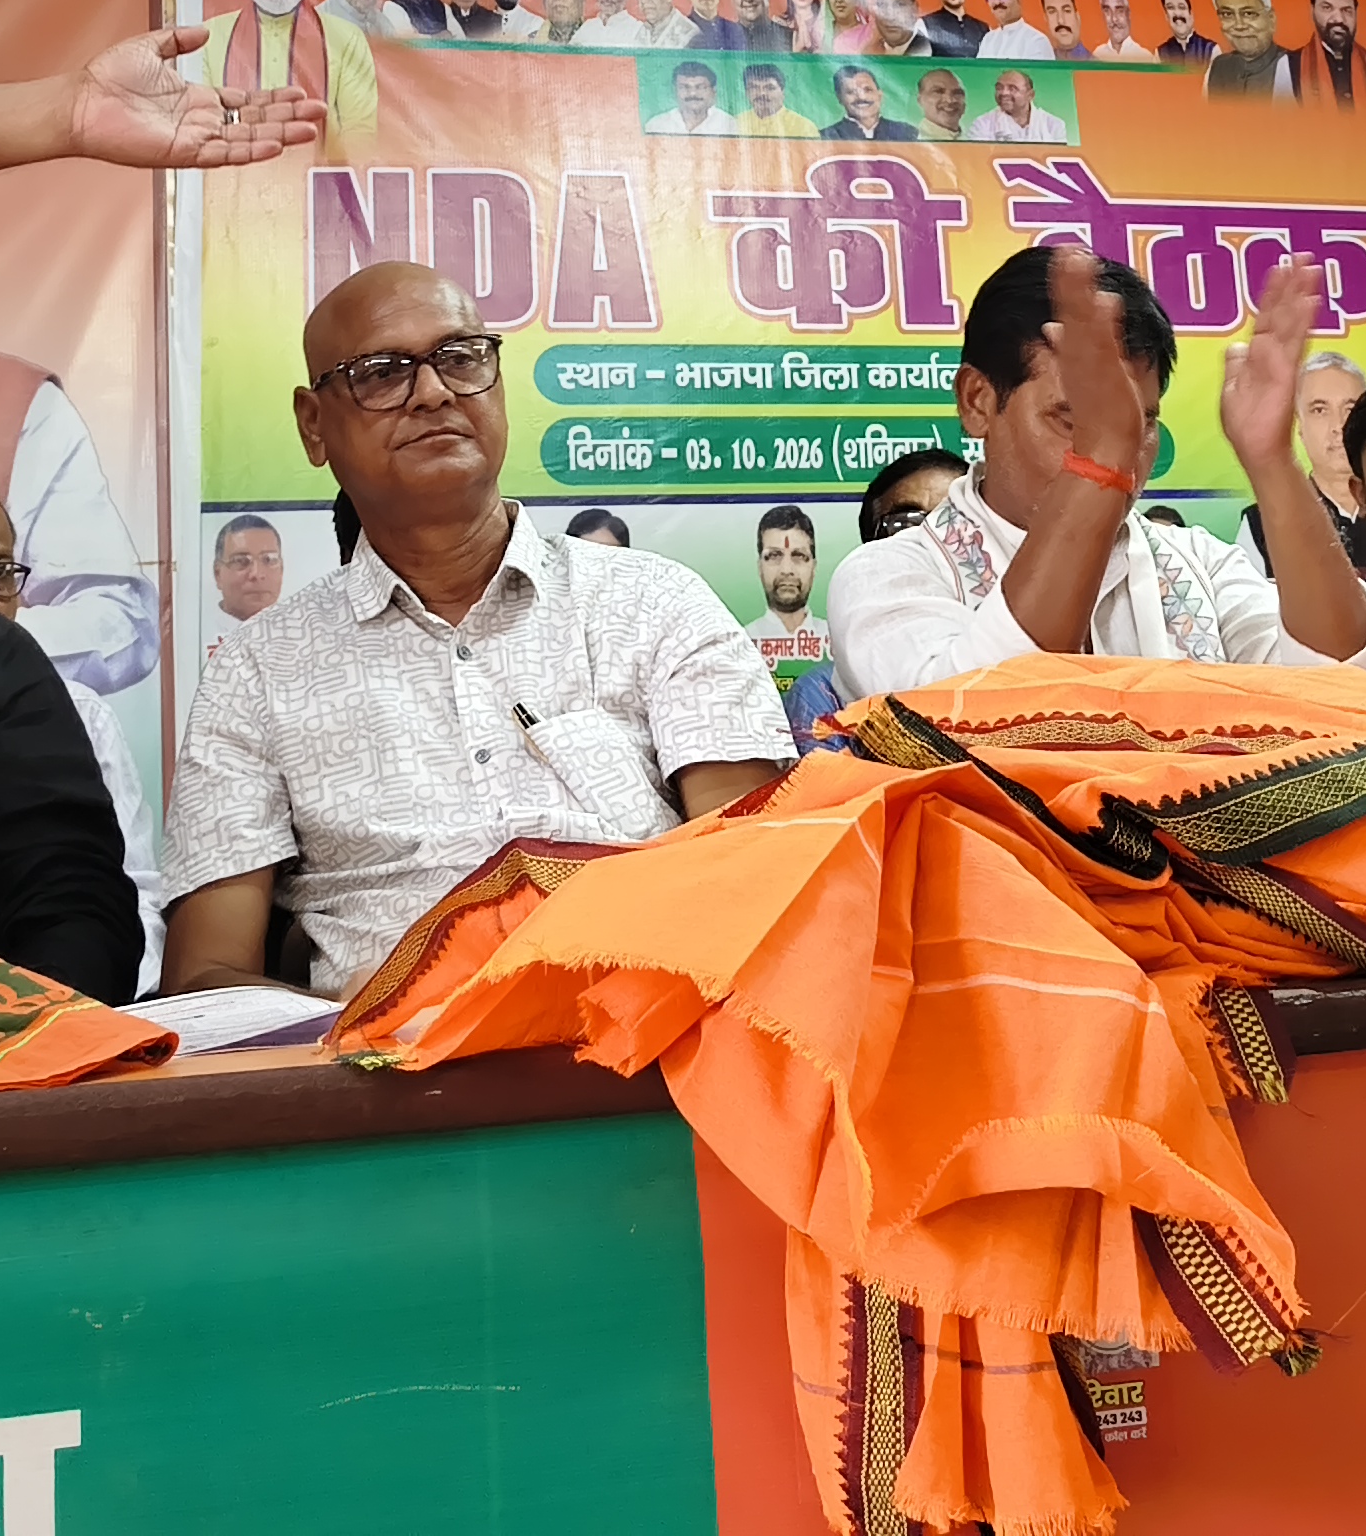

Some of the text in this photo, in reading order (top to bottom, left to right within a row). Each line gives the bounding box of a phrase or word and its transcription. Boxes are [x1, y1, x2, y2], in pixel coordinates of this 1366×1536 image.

[308, 166, 658, 329] NDA
[707, 156, 966, 329] की
[557, 362, 636, 390] स्थान
[674, 362, 773, 389] भाजपा
[781, 352, 859, 391] जिला
[866, 353, 961, 390] कार्याल
[567, 425, 654, 471] दिनांक
[774, 437, 823, 470] 2026
[761, 629, 821, 668] कुमार सिंह
[1086, 1378, 1144, 1408] रिवार
[1120, 1410, 1143, 1424] 243
